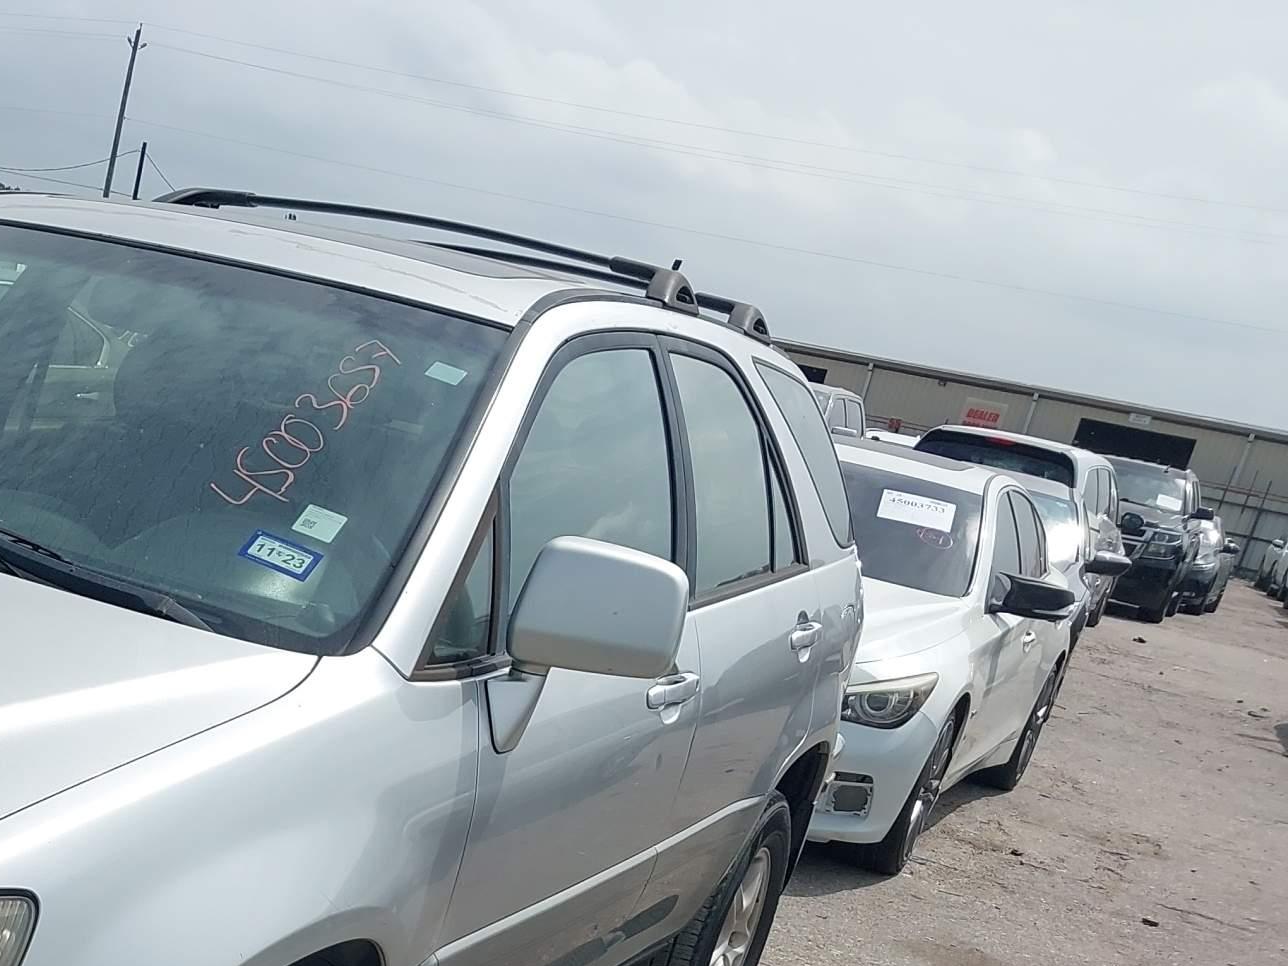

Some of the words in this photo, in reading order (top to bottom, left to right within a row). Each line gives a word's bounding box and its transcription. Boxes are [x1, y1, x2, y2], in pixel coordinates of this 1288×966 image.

[211, 339, 402, 505] 45003657
[966, 408, 1000, 423] DEALER
[889, 497, 945, 513] 45003733
